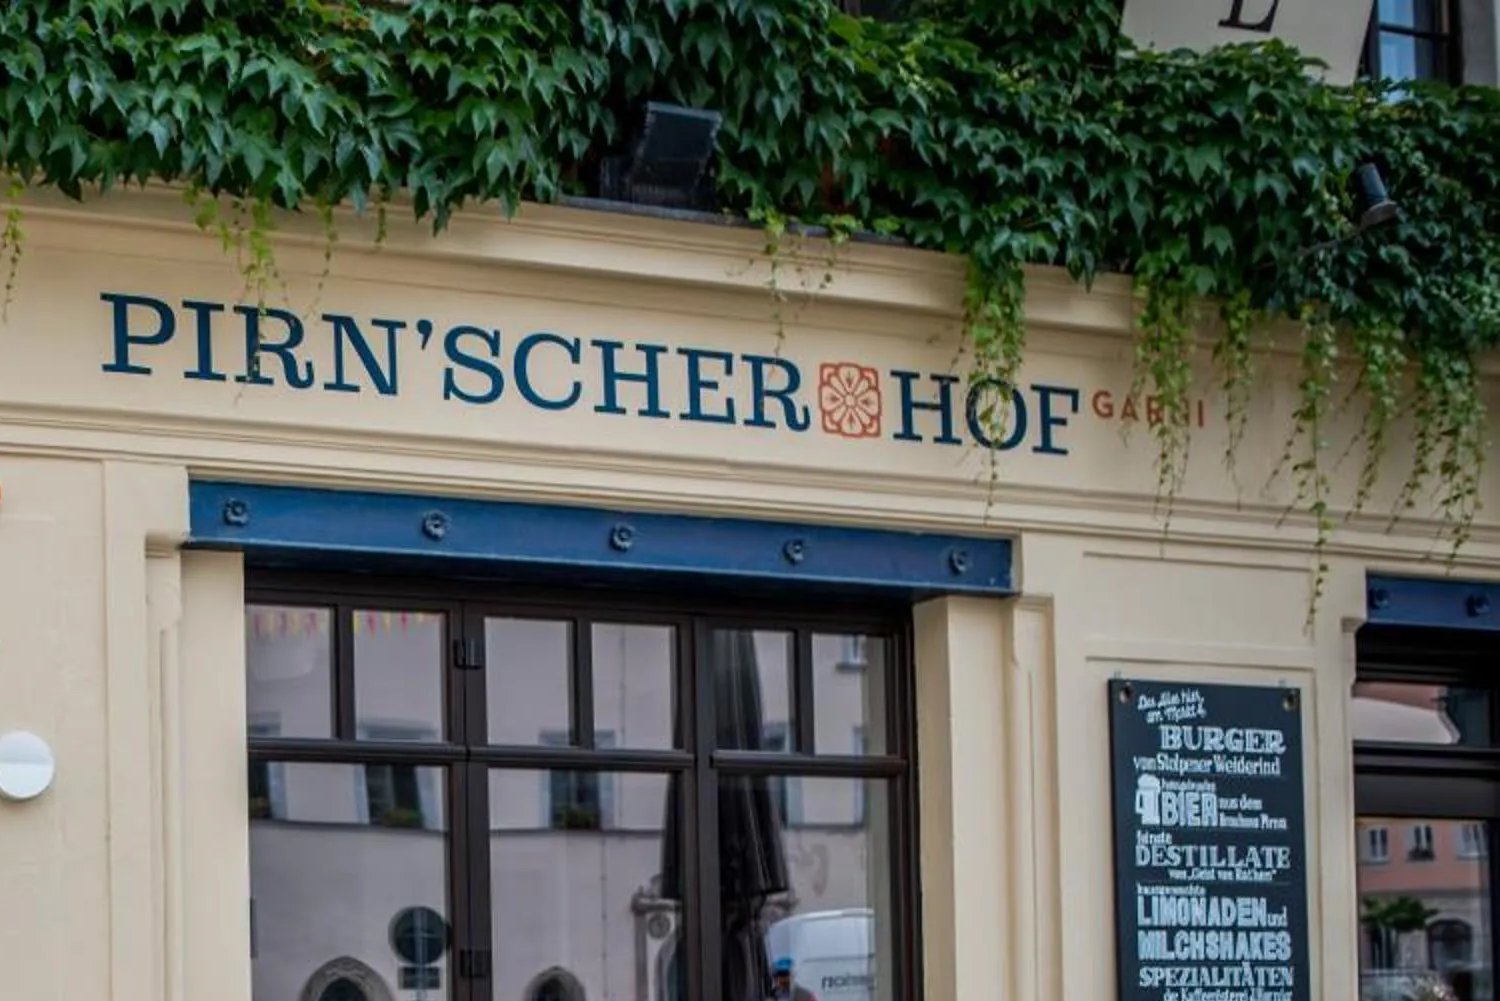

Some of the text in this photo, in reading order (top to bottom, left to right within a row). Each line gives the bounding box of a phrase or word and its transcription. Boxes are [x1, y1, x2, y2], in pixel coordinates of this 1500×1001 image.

[890, 369, 1080, 456] HOF
[1160, 724, 1286, 754] BURGER
[1161, 791, 1218, 827] BIER
[1135, 844, 1291, 869] DESTILLATE
[1137, 895, 1288, 927] LIMONADEN und
[1138, 930, 1292, 961] MILCHSHAKES
[1139, 961, 1294, 987] SPEZIALITÄTEN
